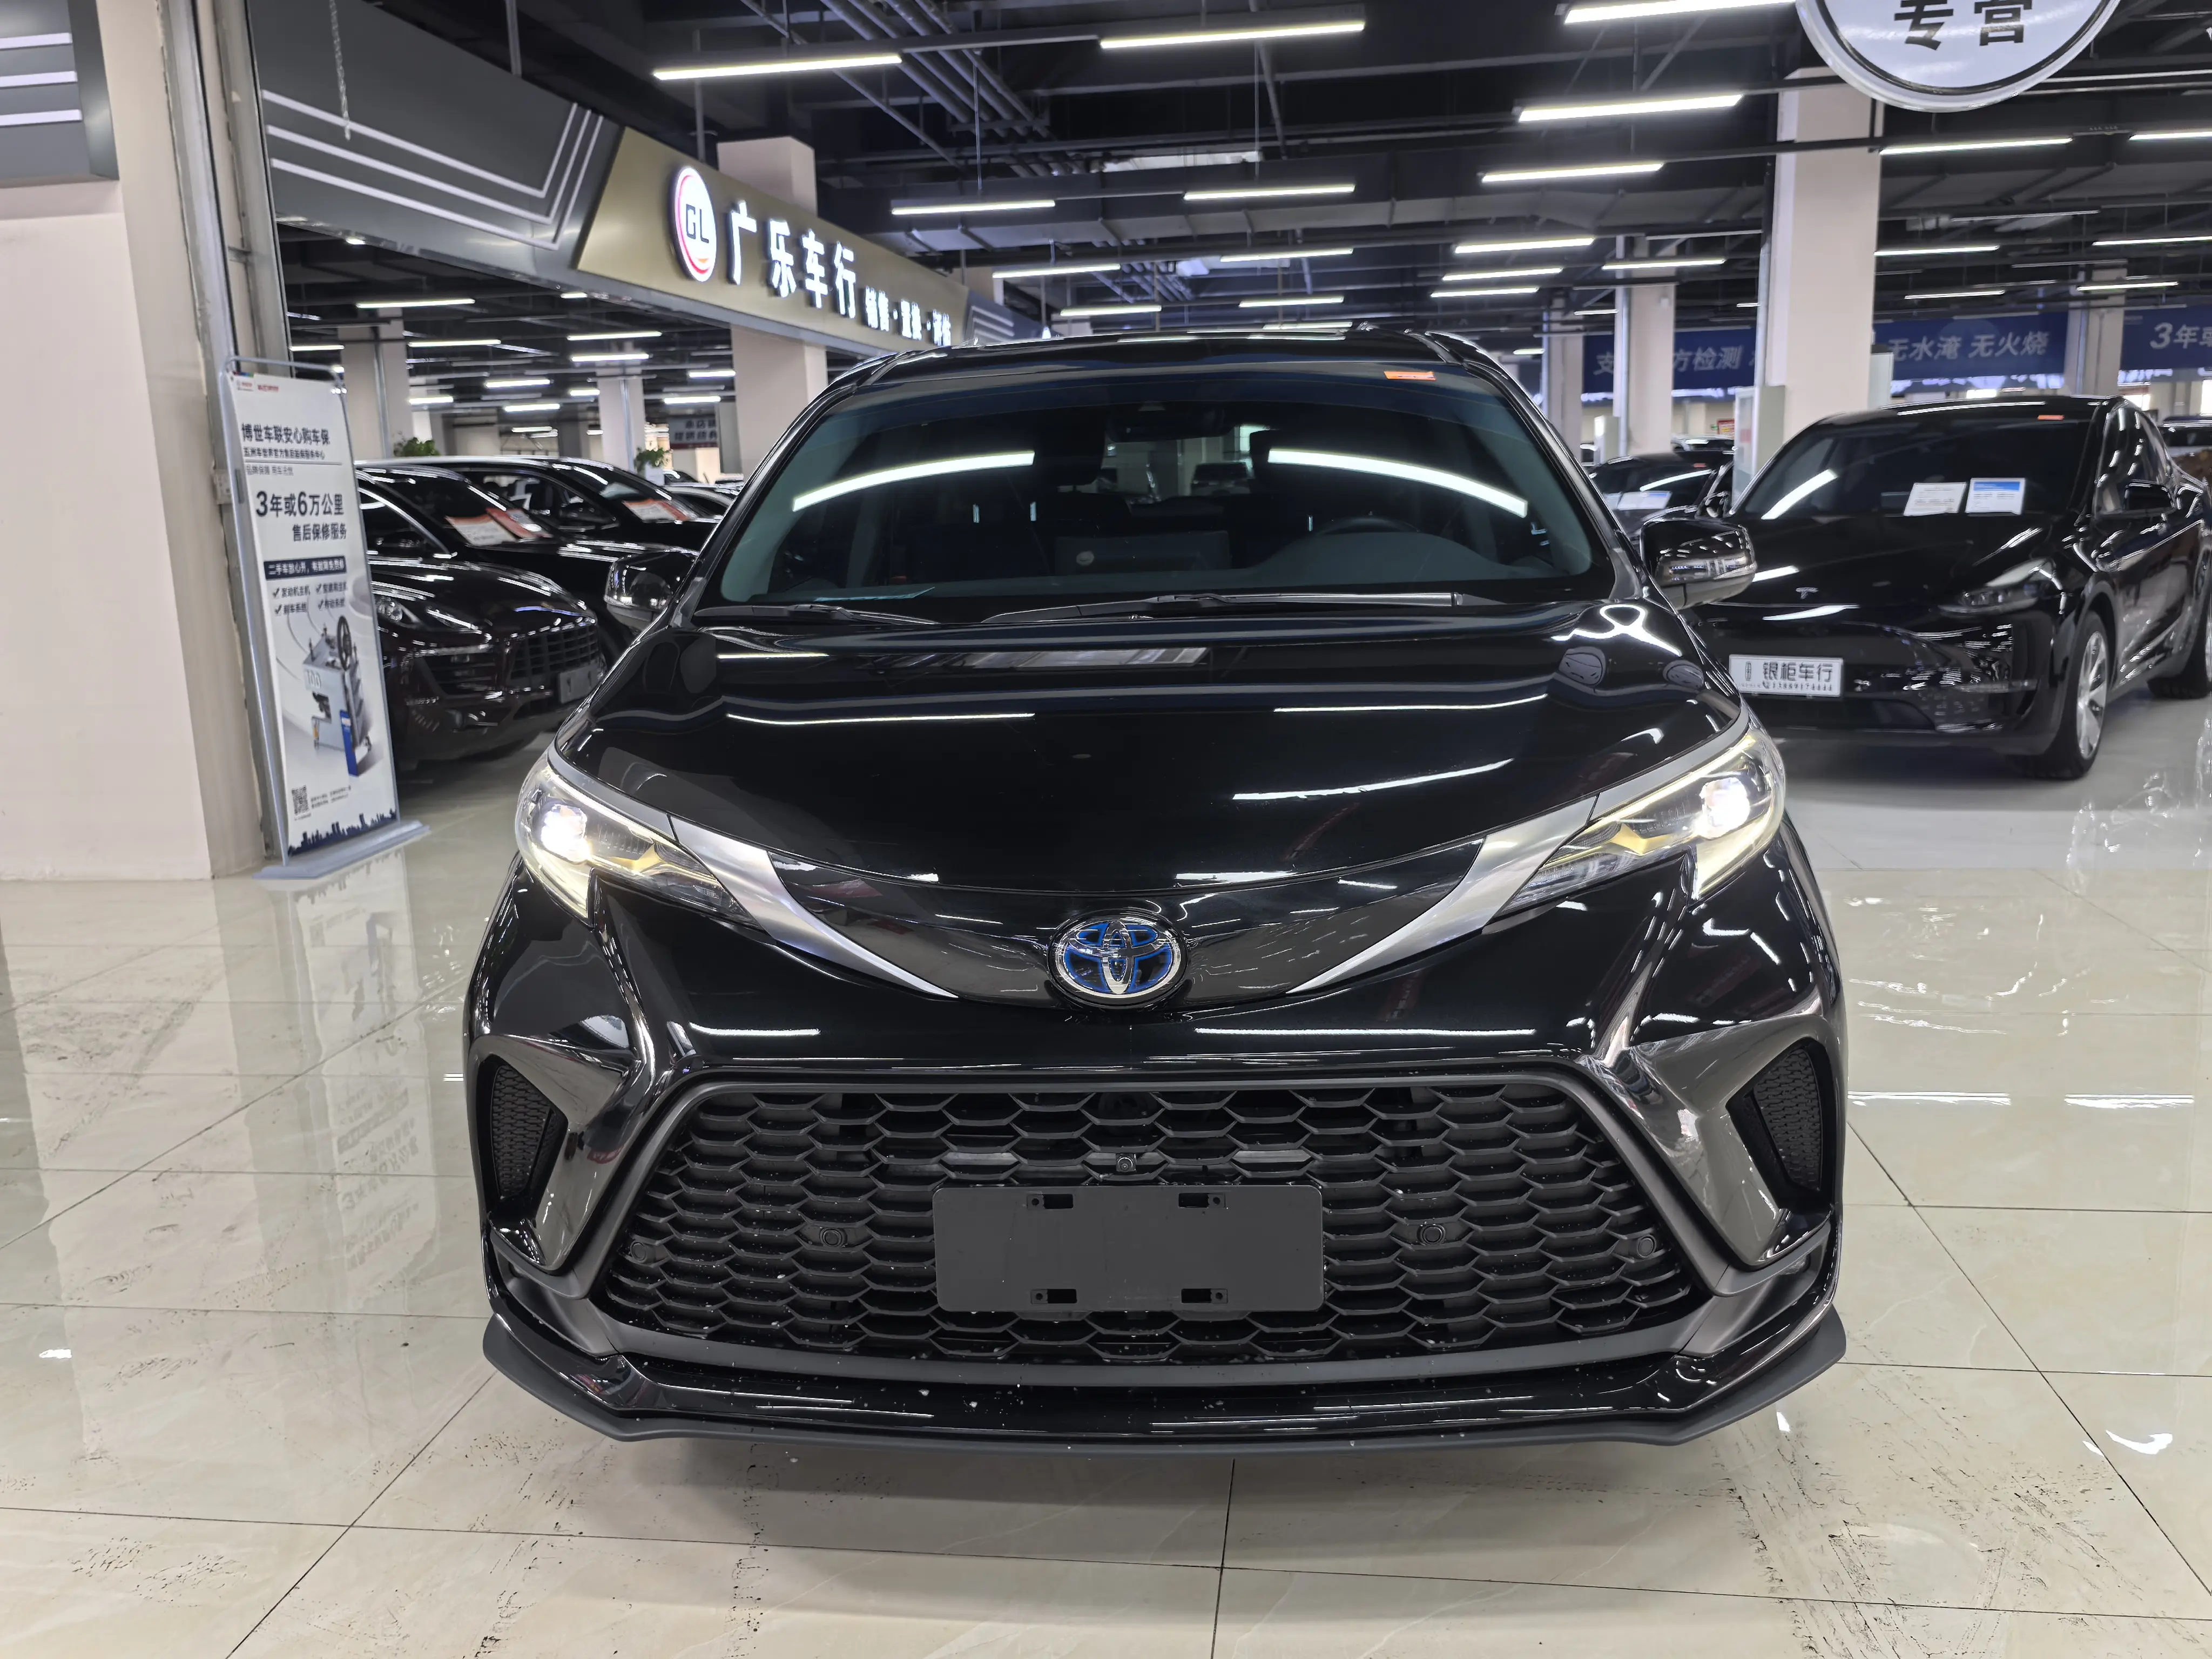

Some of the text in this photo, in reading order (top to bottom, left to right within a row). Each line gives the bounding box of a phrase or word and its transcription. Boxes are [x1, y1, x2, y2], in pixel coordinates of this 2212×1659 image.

[686, 204, 709, 244] GL
[731, 200, 856, 319] 广乐车行
[1968, 331, 2051, 359] 无火烧
[256, 490, 344, 517] 3年或6万公里
[292, 522, 347, 542] 售后保修服务
